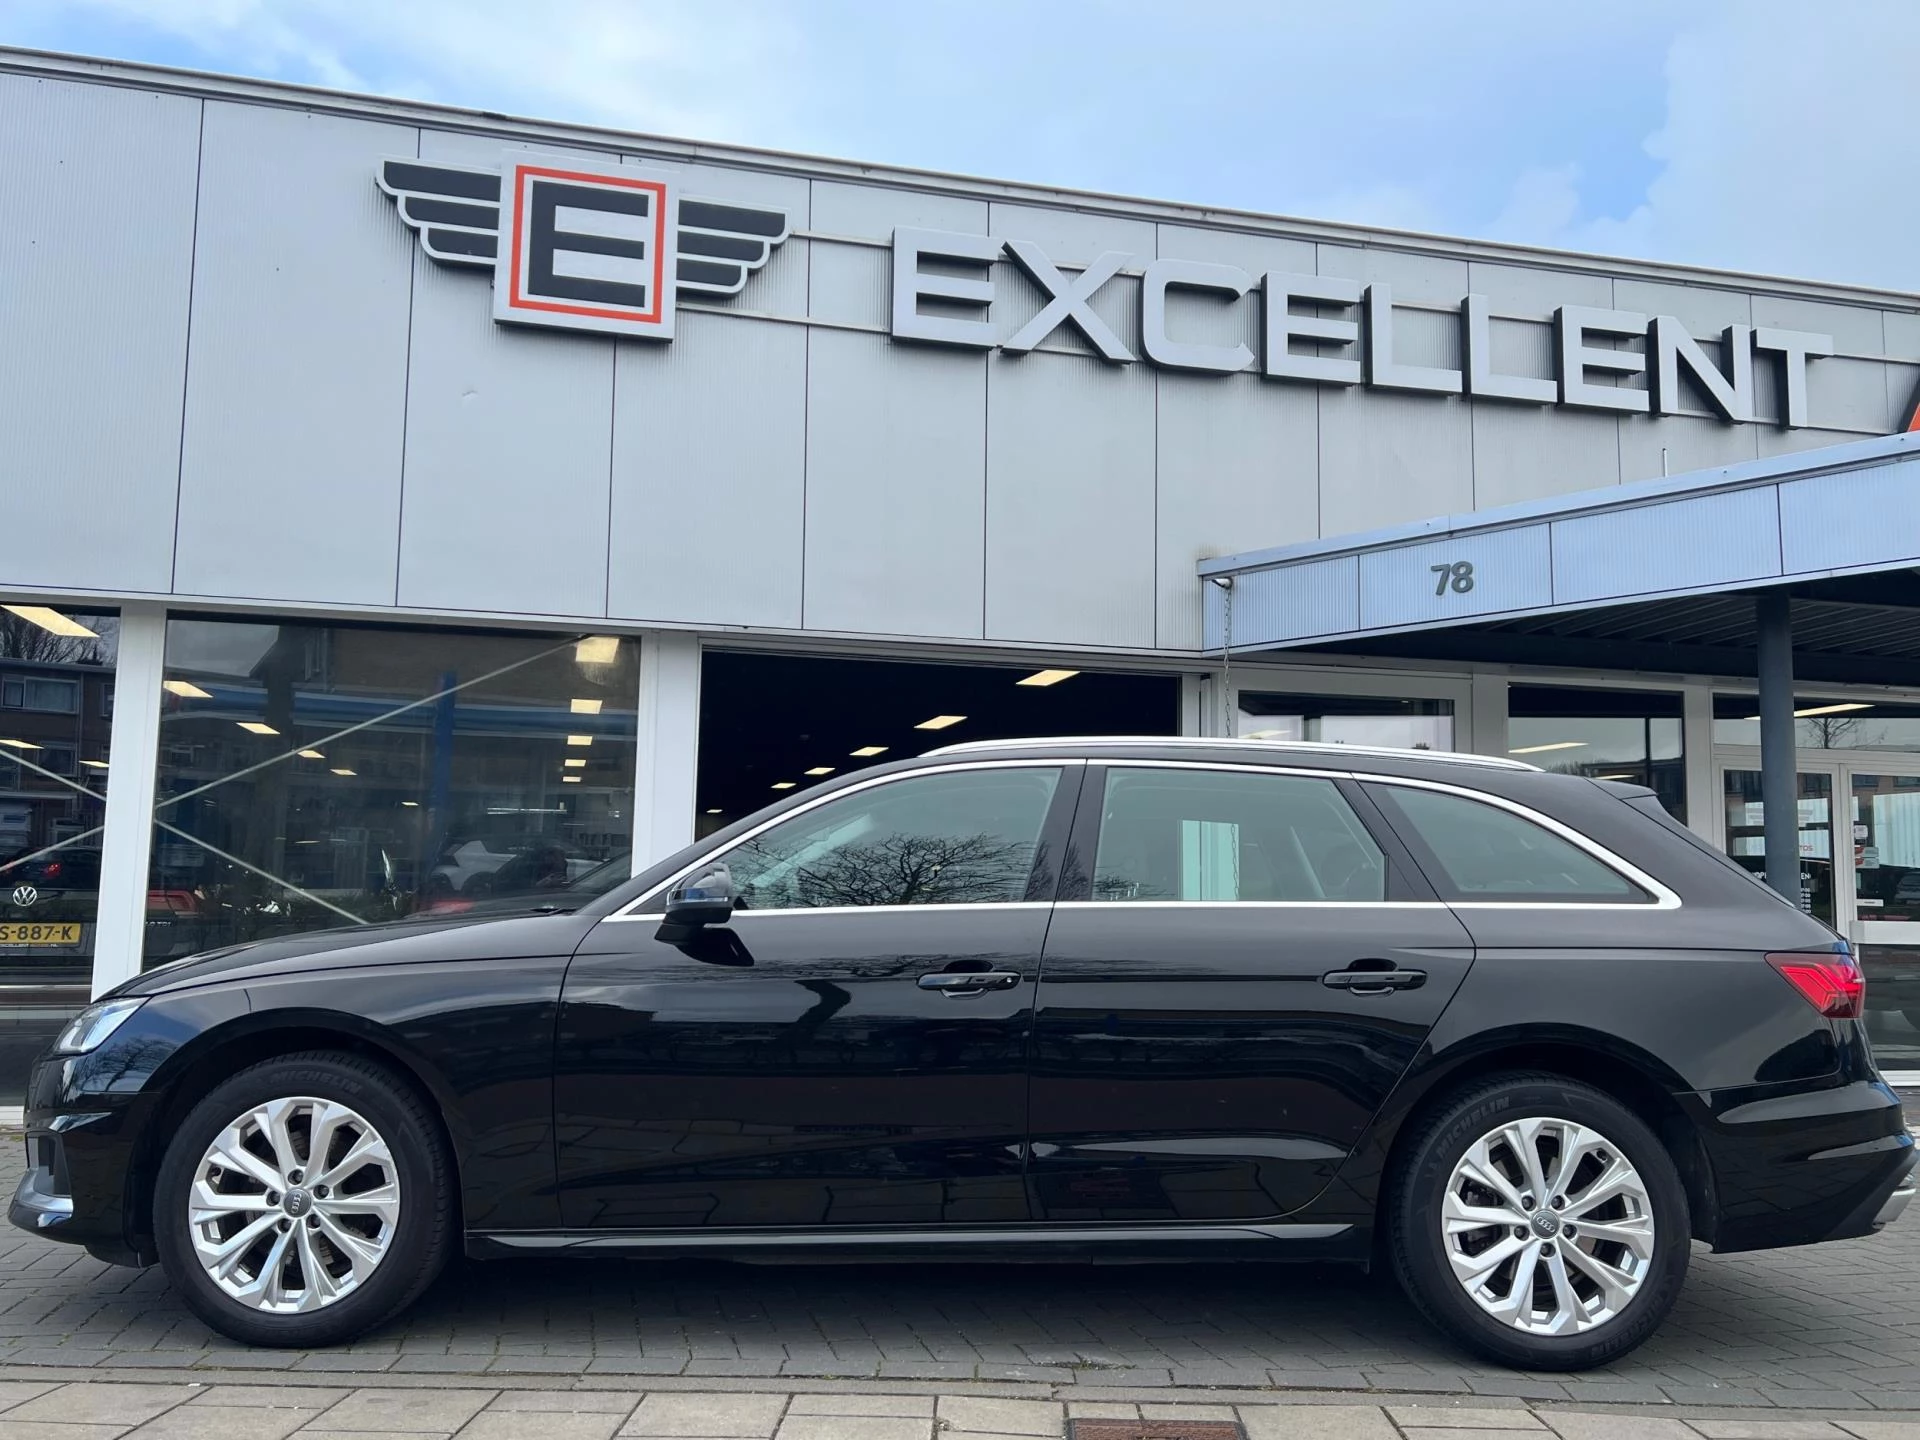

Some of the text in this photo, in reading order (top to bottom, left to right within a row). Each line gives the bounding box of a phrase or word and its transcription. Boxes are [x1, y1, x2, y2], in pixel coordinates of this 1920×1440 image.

[892, 226, 1834, 429] EXCELLENT
[1430, 561, 1474, 596] 78
[1437, 1096, 1510, 1158] MICHELIN
